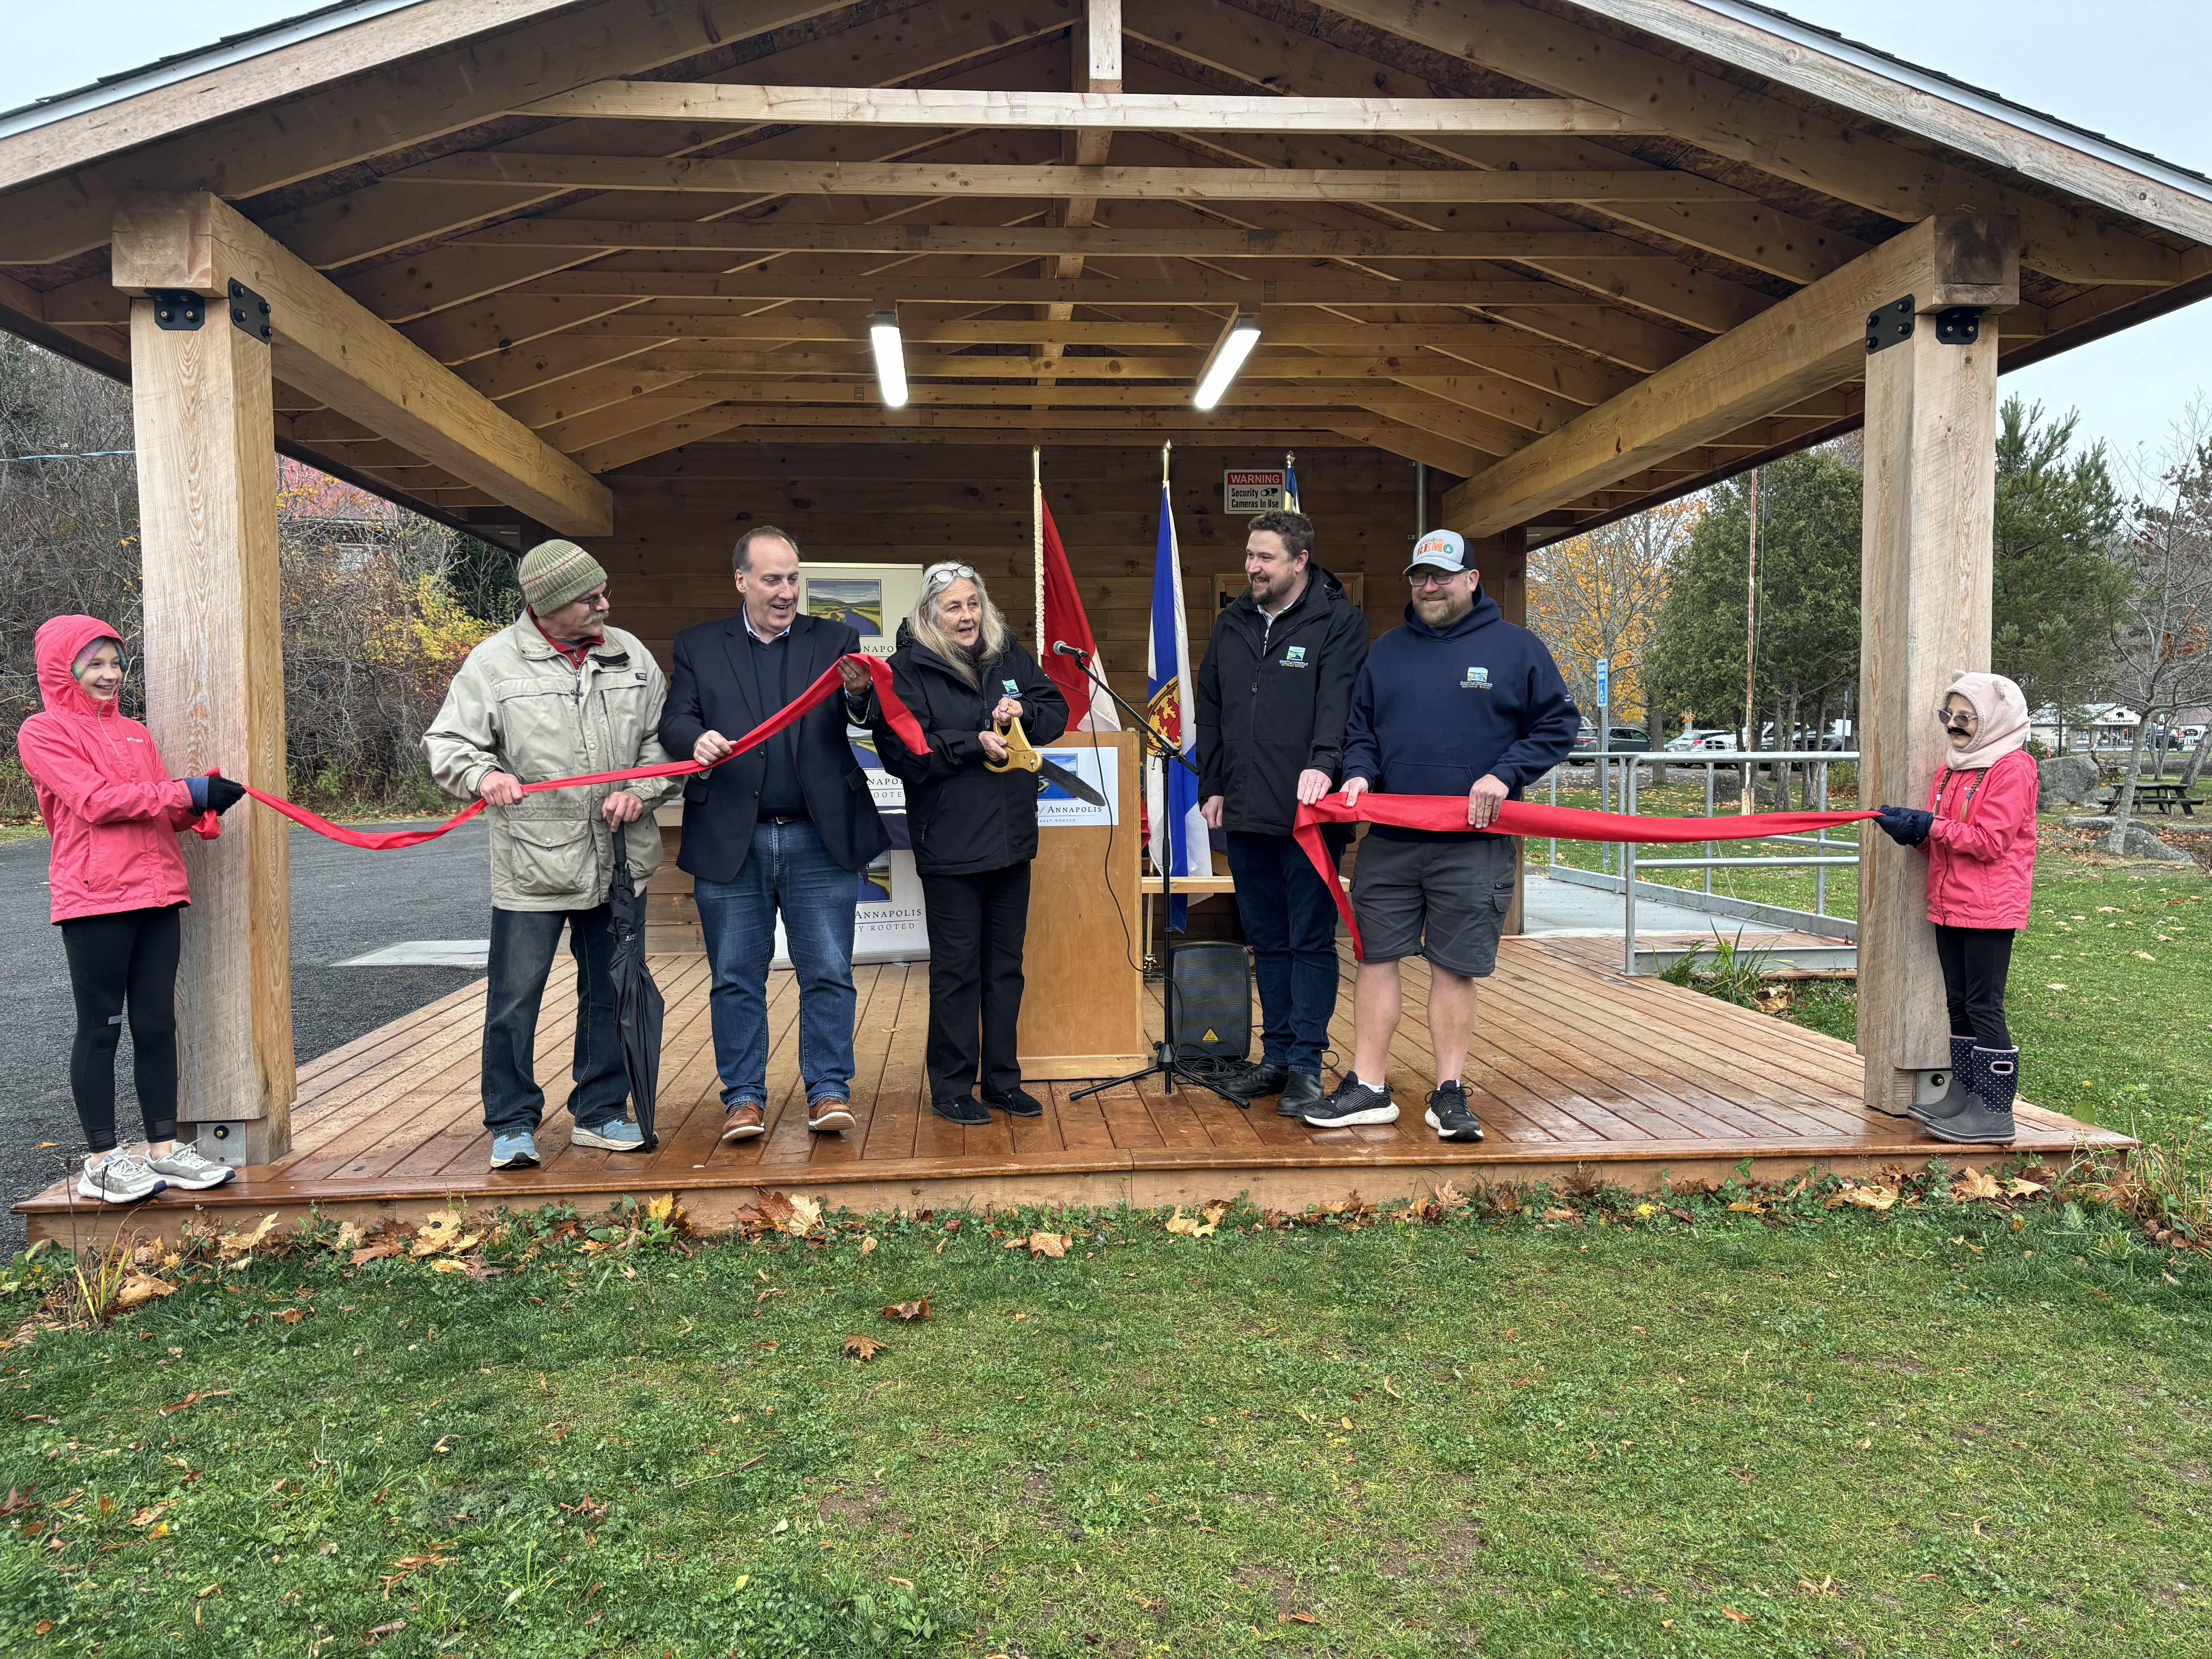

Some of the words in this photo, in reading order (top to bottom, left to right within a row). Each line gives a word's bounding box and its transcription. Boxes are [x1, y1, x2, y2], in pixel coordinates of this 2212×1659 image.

[1231, 474, 1279, 484] WARNING
[1231, 488, 1259, 498] Security
[1231, 499, 1258, 508] Cameras
[1260, 499, 1266, 508] In
[1268, 499, 1279, 508] Use
[855, 909, 922, 919] ANNAPOLIS
[871, 923, 915, 931] ROOTED
